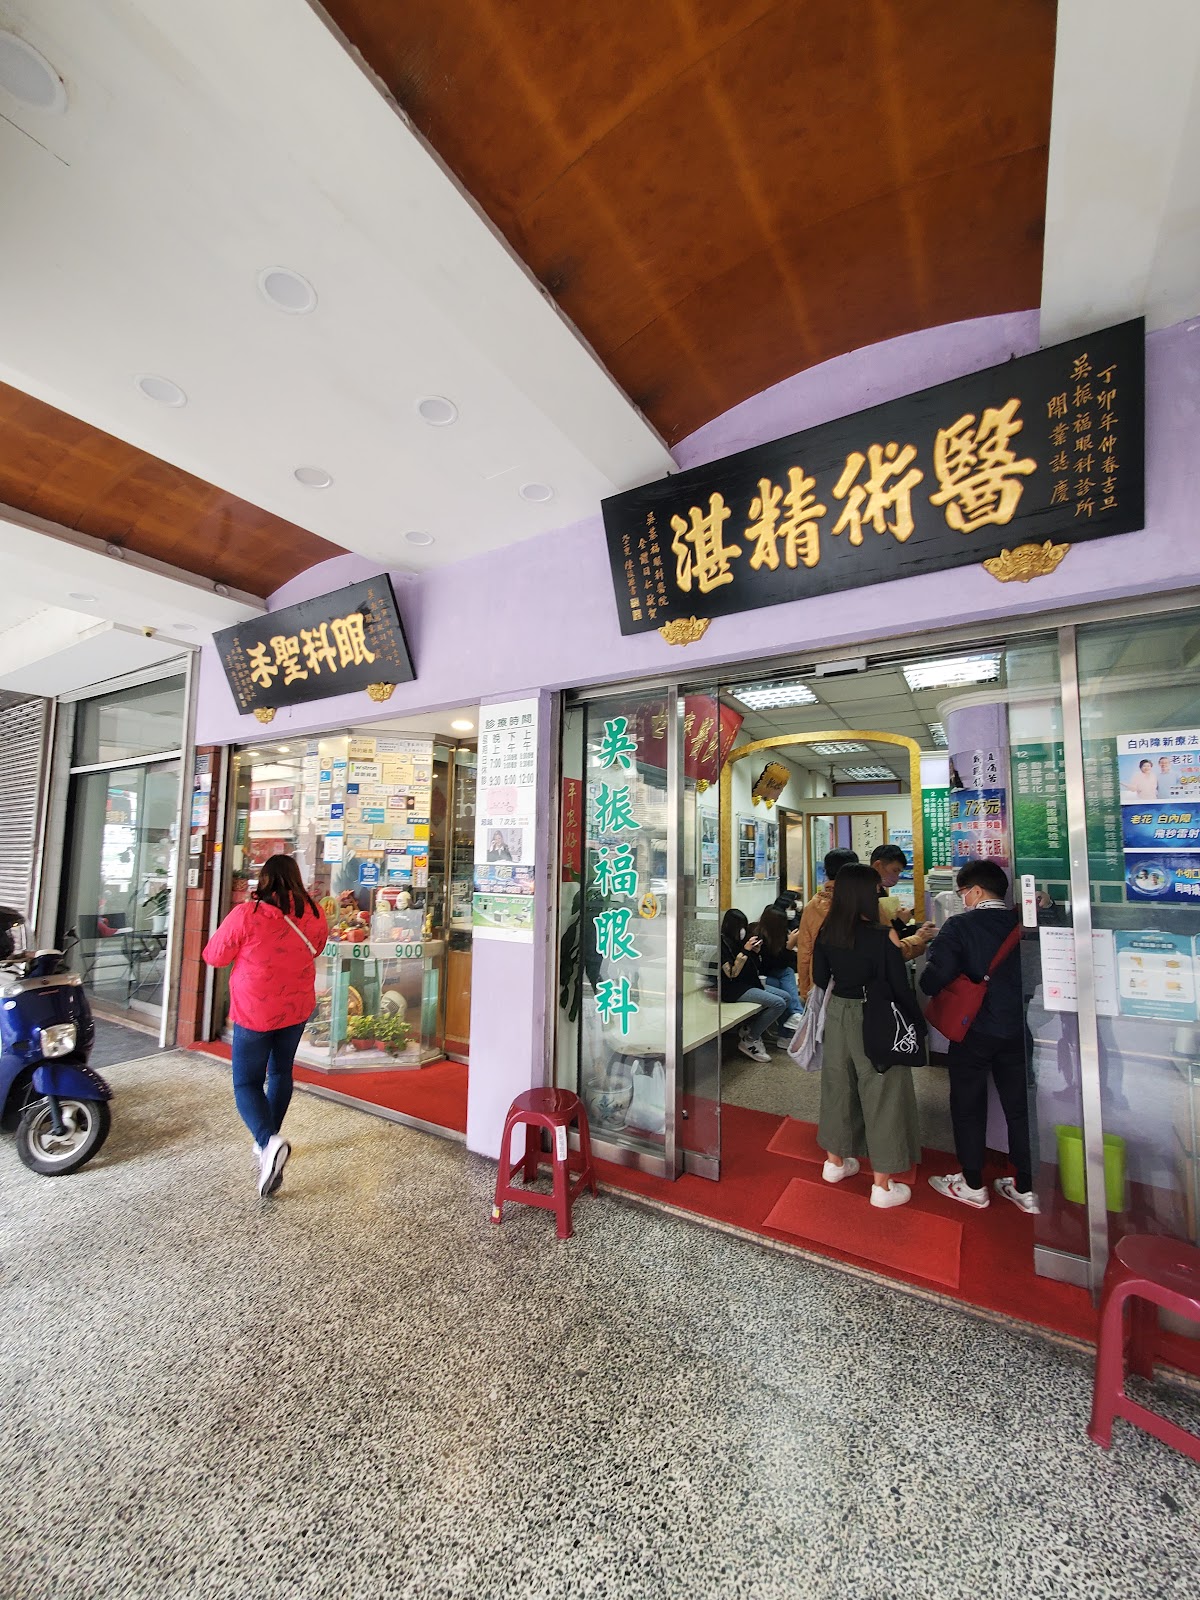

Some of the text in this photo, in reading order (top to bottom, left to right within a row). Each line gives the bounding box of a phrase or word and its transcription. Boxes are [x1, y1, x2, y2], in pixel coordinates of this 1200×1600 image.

[1070, 353, 1097, 518] 吳振福眼科診所
[1096, 364, 1120, 511] 丁卯年仲春吉旦
[1047, 392, 1069, 505] 開業誌慶
[670, 397, 1037, 594] 醫術精湛
[485, 714, 532, 730] 診療時間
[492, 733, 500, 755] 晚上
[507, 731, 515, 754] 下午
[523, 730, 531, 752] 上午
[1127, 734, 1199, 751] 白內障新療法
[1170, 754, 1194, 765] 老花
[489, 775, 500, 786] 9:30
[504, 774, 516, 785] 6:00
[519, 773, 533, 784] 12:00
[1130, 813, 1192, 824] 老花 白內障
[1153, 828, 1200, 839] 飛秒雷射
[593, 716, 642, 1038] 吳振福眼科
[352, 944, 370, 959] 60
[395, 944, 423, 958] 900
